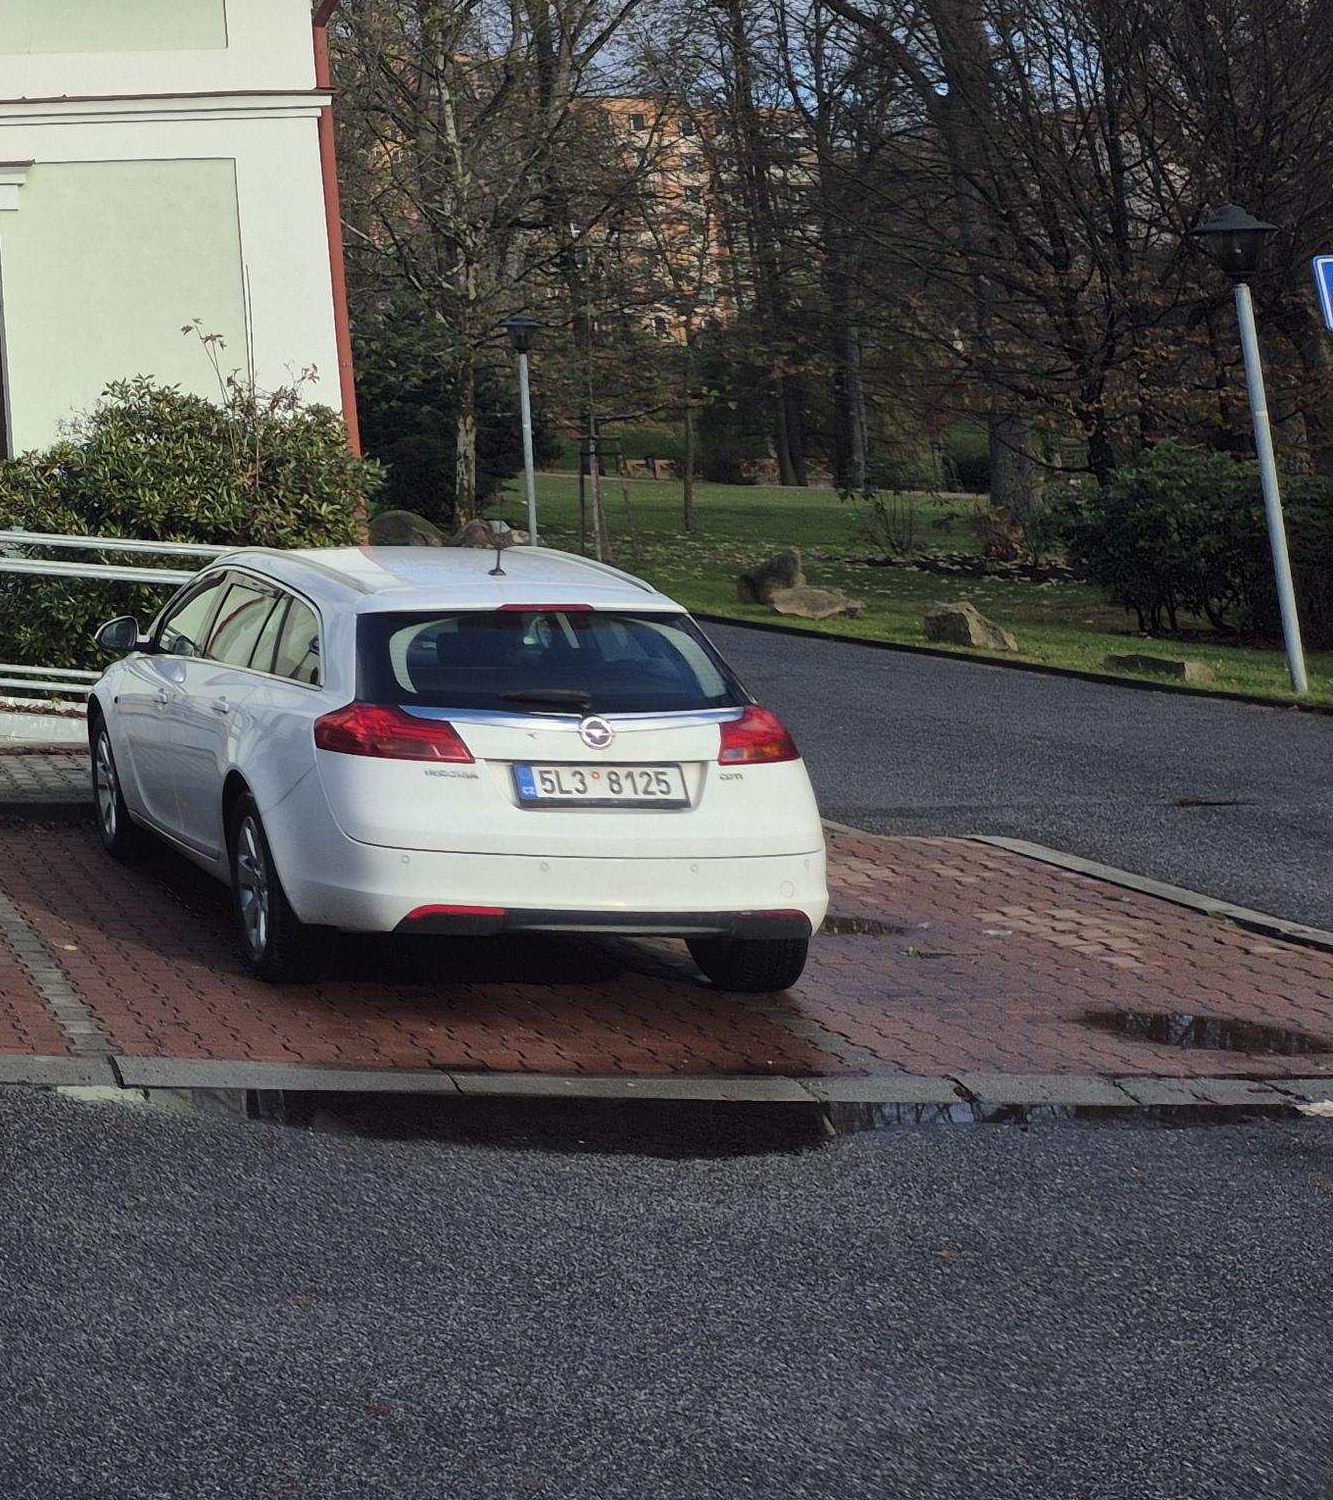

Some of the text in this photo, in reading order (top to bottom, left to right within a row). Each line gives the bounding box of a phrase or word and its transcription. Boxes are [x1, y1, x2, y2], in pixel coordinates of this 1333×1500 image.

[522, 786, 535, 795] CZ
[539, 770, 672, 796] 5L3 8125
